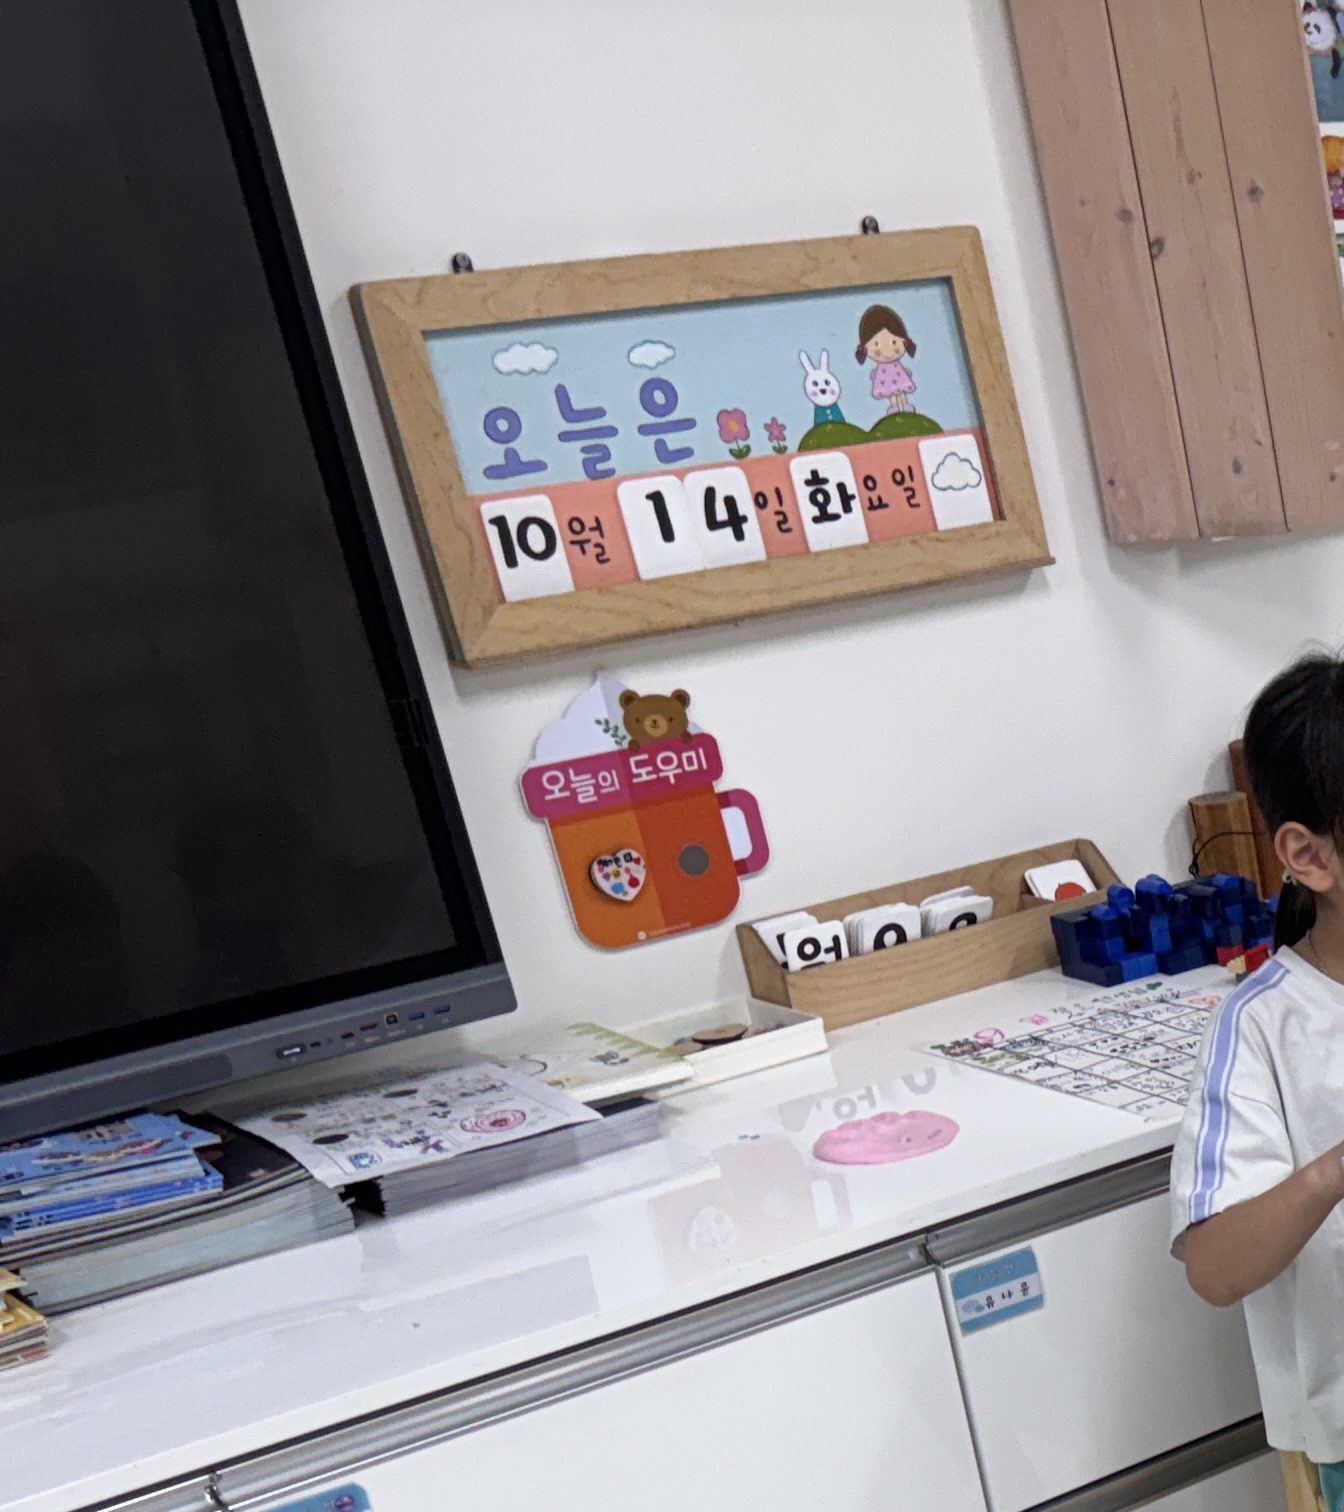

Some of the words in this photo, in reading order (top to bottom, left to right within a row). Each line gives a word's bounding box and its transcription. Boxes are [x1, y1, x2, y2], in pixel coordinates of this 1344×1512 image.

[483, 376, 697, 481] 오늘은
[541, 767, 620, 804] 오늘의
[629, 747, 707, 785] 도우미
